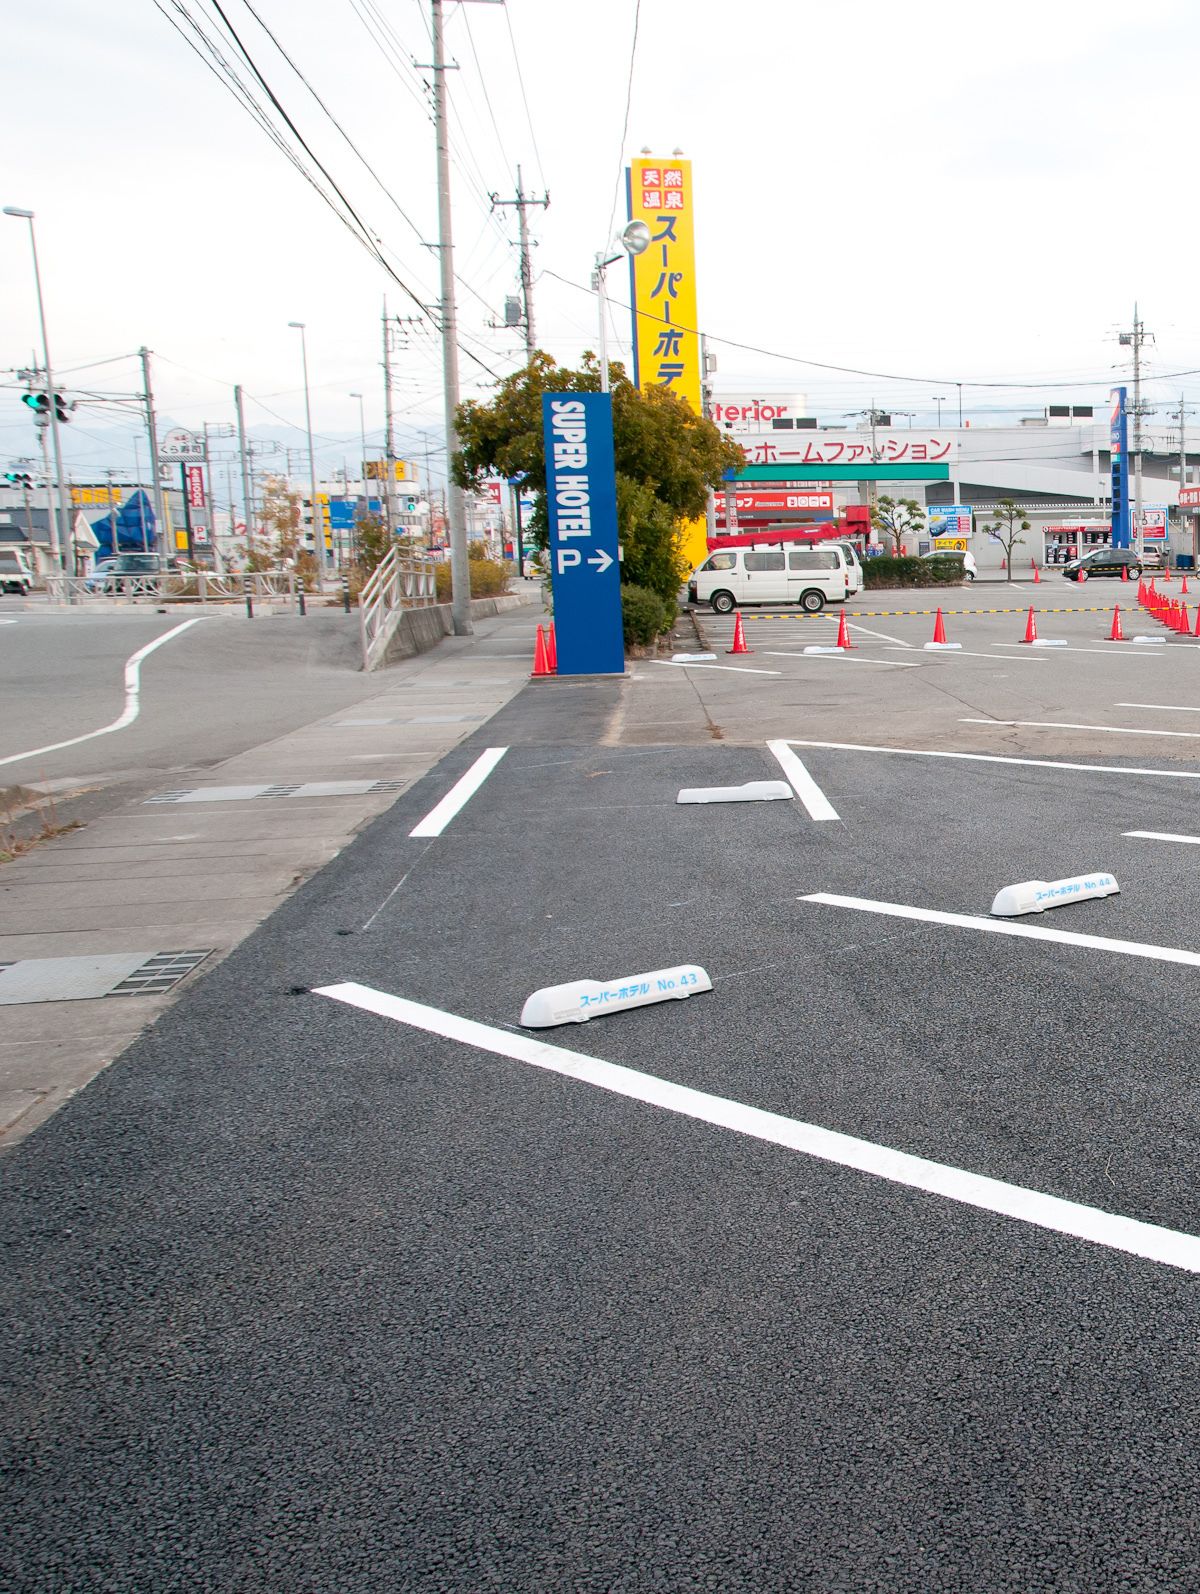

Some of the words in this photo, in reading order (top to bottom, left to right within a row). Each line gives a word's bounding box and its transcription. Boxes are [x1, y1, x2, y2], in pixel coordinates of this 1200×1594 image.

[643, 170, 682, 187] 天然
[643, 191, 683, 208] 温泉
[650, 215, 687, 398] スーパーホテ
[551, 400, 588, 470] SUPER
[555, 475, 592, 542] HOTEL
[557, 549, 582, 575] P
[1035, 883, 1081, 901] スーパーホテル
[579, 982, 651, 1009] スーパーホテル
